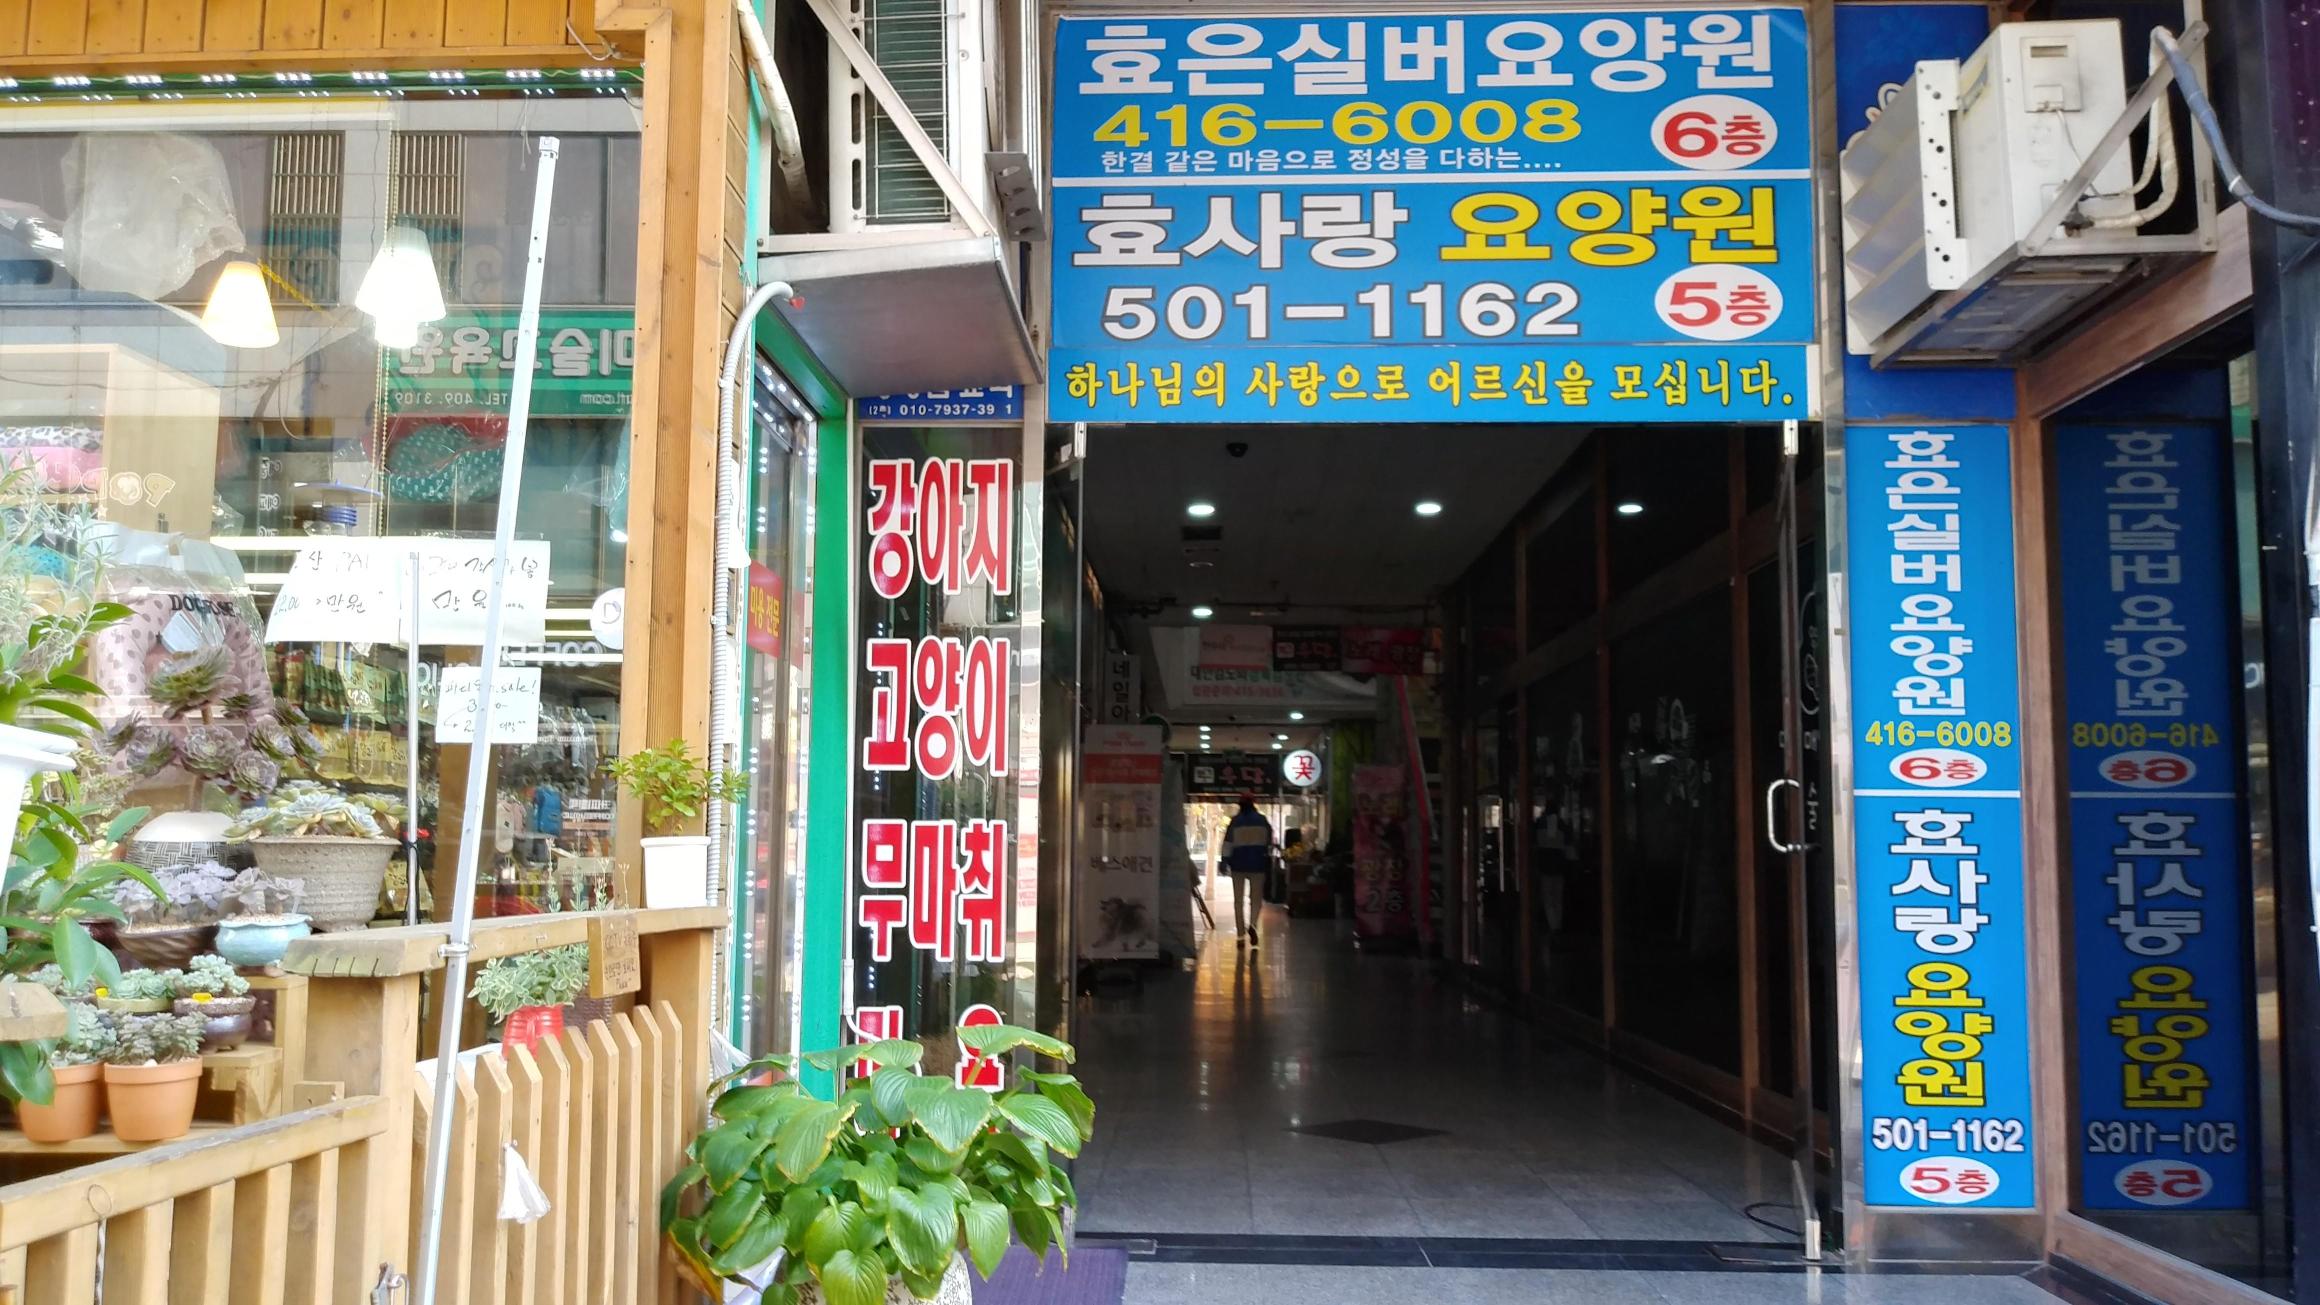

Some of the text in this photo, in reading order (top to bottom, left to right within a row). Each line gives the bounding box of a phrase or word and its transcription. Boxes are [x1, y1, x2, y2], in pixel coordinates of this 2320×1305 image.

[1079, 14, 1774, 96] 효은실버요양원
[1093, 99, 1582, 148] 416-6008
[1663, 111, 1766, 158] 6층
[1102, 151, 1153, 174] 한결
[1165, 151, 1218, 173] 같은
[1228, 149, 1337, 172] 마음으로
[1347, 147, 1429, 171] 정성을
[1072, 186, 1778, 269] 효사랑 요양원
[1102, 281, 1581, 340] 501-1162
[1668, 282, 1771, 327] 5층
[1065, 359, 1793, 408] 하나님의 사랑으로 어르신을 모십니다.
[899, 404, 1012, 416] 010-7937-391
[866, 456, 1014, 599] 강아지
[1884, 431, 1973, 716] 효은실버요양원
[863, 635, 1010, 780] 고양이
[1865, 721, 2011, 747] 416-6008
[1292, 755, 1315, 780] 꽃
[1899, 757, 1978, 780] 6층
[859, 818, 1007, 963] 무마취
[1889, 809, 1994, 1106] 효사랑 요양원
[1871, 1117, 2024, 1153] 501-1162
[1910, 1167, 1990, 1194] 5층
